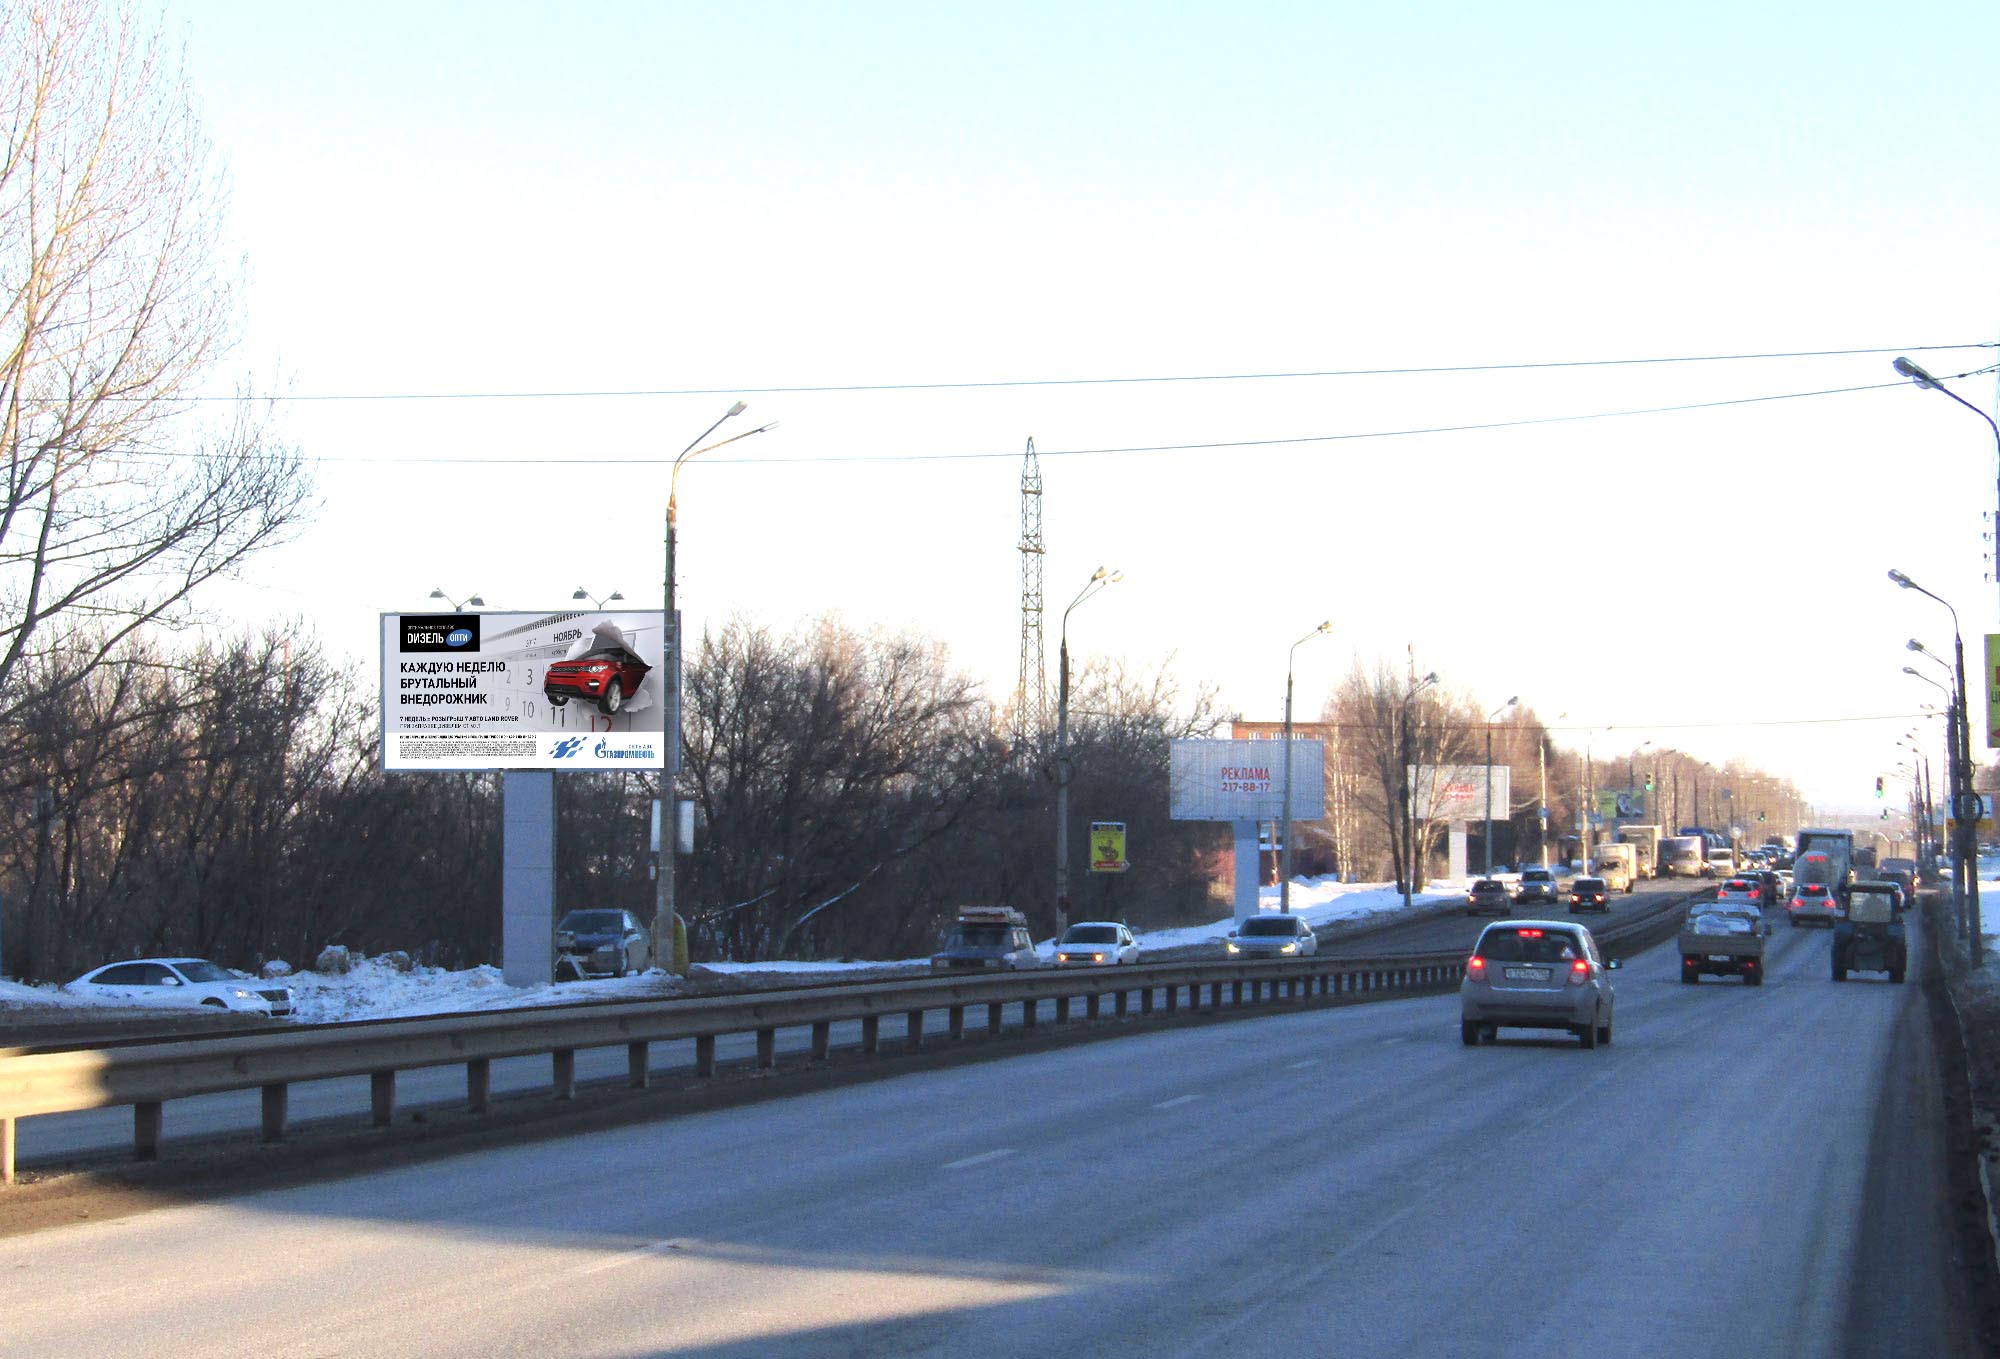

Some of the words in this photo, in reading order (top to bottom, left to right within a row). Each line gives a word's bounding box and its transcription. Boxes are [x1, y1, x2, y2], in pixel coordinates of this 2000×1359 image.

[450, 633, 468, 642] ОПТИ
[553, 628, 582, 642] НОЯБРЬ
[400, 662, 454, 674] КАЖДУЮ
[456, 662, 506, 674] НЕДЕЛЮ
[400, 676, 477, 689] БРУТАЛЬНЫЙ
[526, 668, 533, 685] 3
[400, 693, 487, 706] ВНЕДОРОЖНИК
[522, 700, 535, 718] 10
[550, 706, 566, 727] 11
[606, 750, 655, 758] ГАЗПРОМНЕФТЬ
[1221, 767, 1270, 780] РЕКЛАМА
[1222, 782, 1271, 792] 217-88-17
